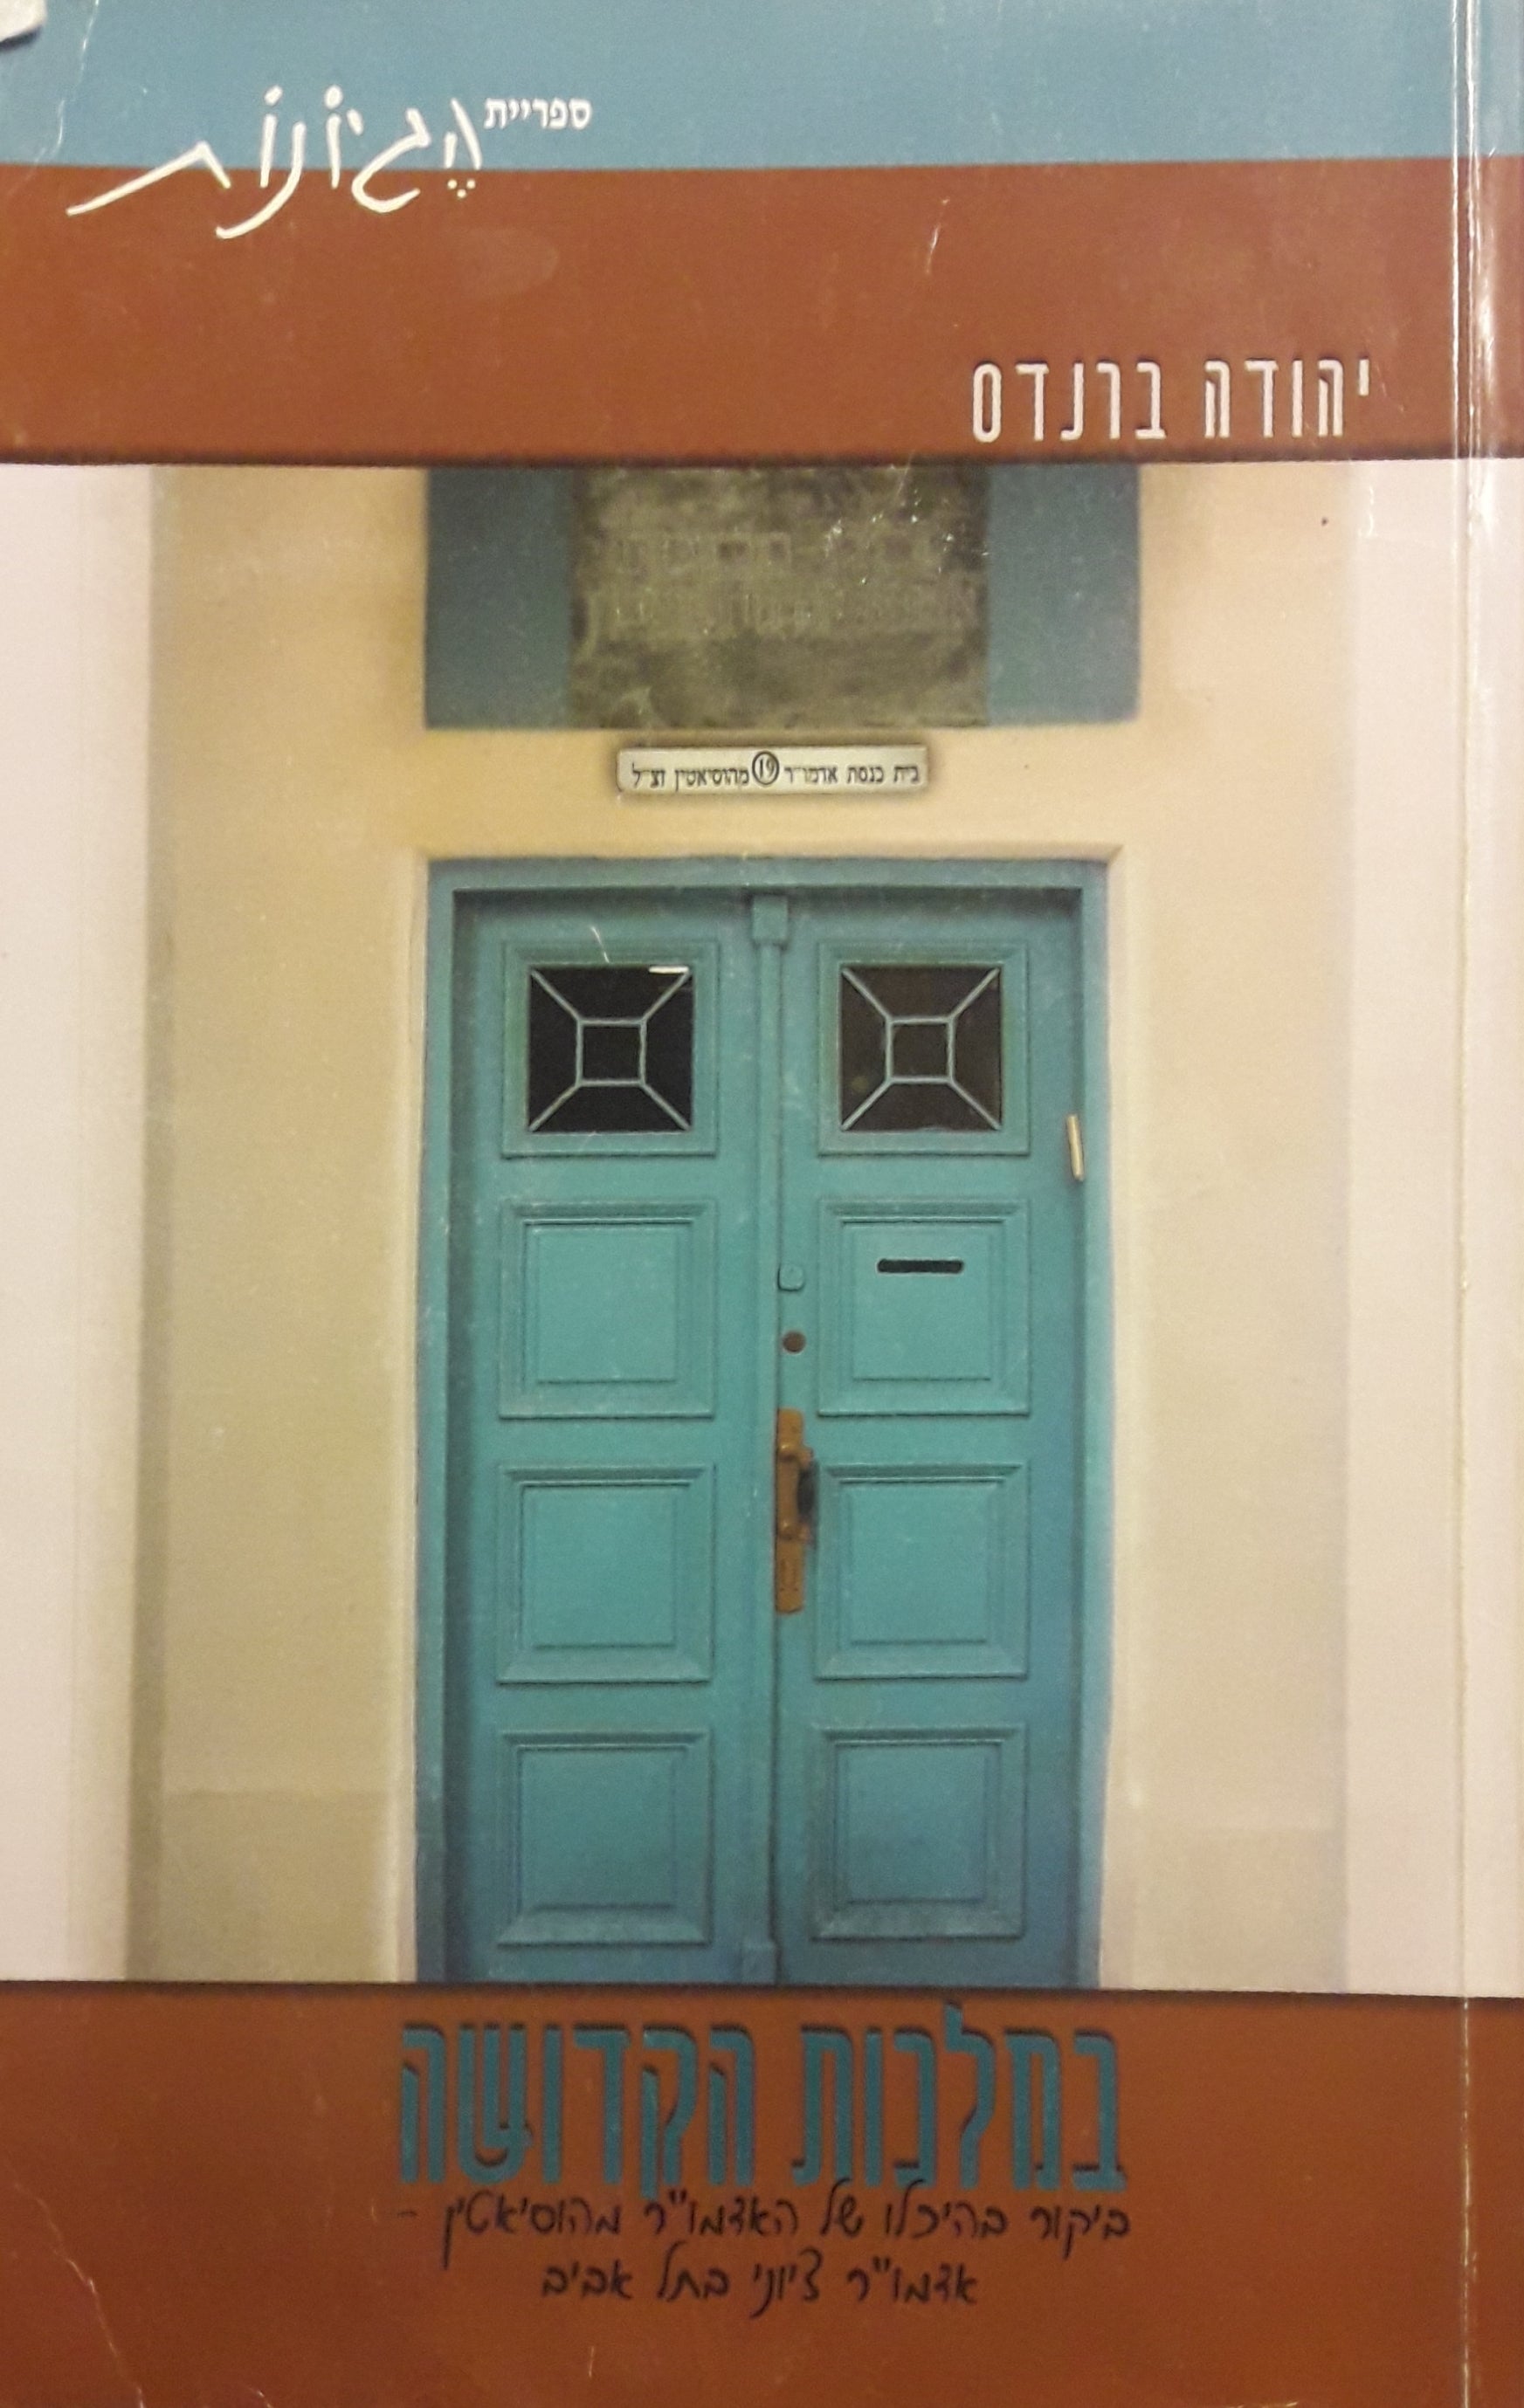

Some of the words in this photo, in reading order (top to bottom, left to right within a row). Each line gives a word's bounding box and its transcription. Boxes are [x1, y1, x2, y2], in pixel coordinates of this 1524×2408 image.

[483, 97, 593, 130] ספריית
[971, 361, 1166, 443] ברנדס
[1203, 357, 1370, 439] יהודה
[756, 753, 776, 782] 19
[846, 764, 885, 784] כנסת
[893, 763, 921, 784] בית
[398, 2021, 757, 2201] הקדושה
[790, 2000, 1127, 2192] במלכות
[442, 2190, 621, 2270] מהוסיאטין
[820, 2178, 864, 2237] של
[884, 2178, 1010, 2239] בהיכלו
[1031, 2205, 1131, 2260] ביקור
[541, 2259, 634, 2301] אביב
[657, 2240, 731, 2302] בתל
[749, 2246, 824, 2319] ציוני
